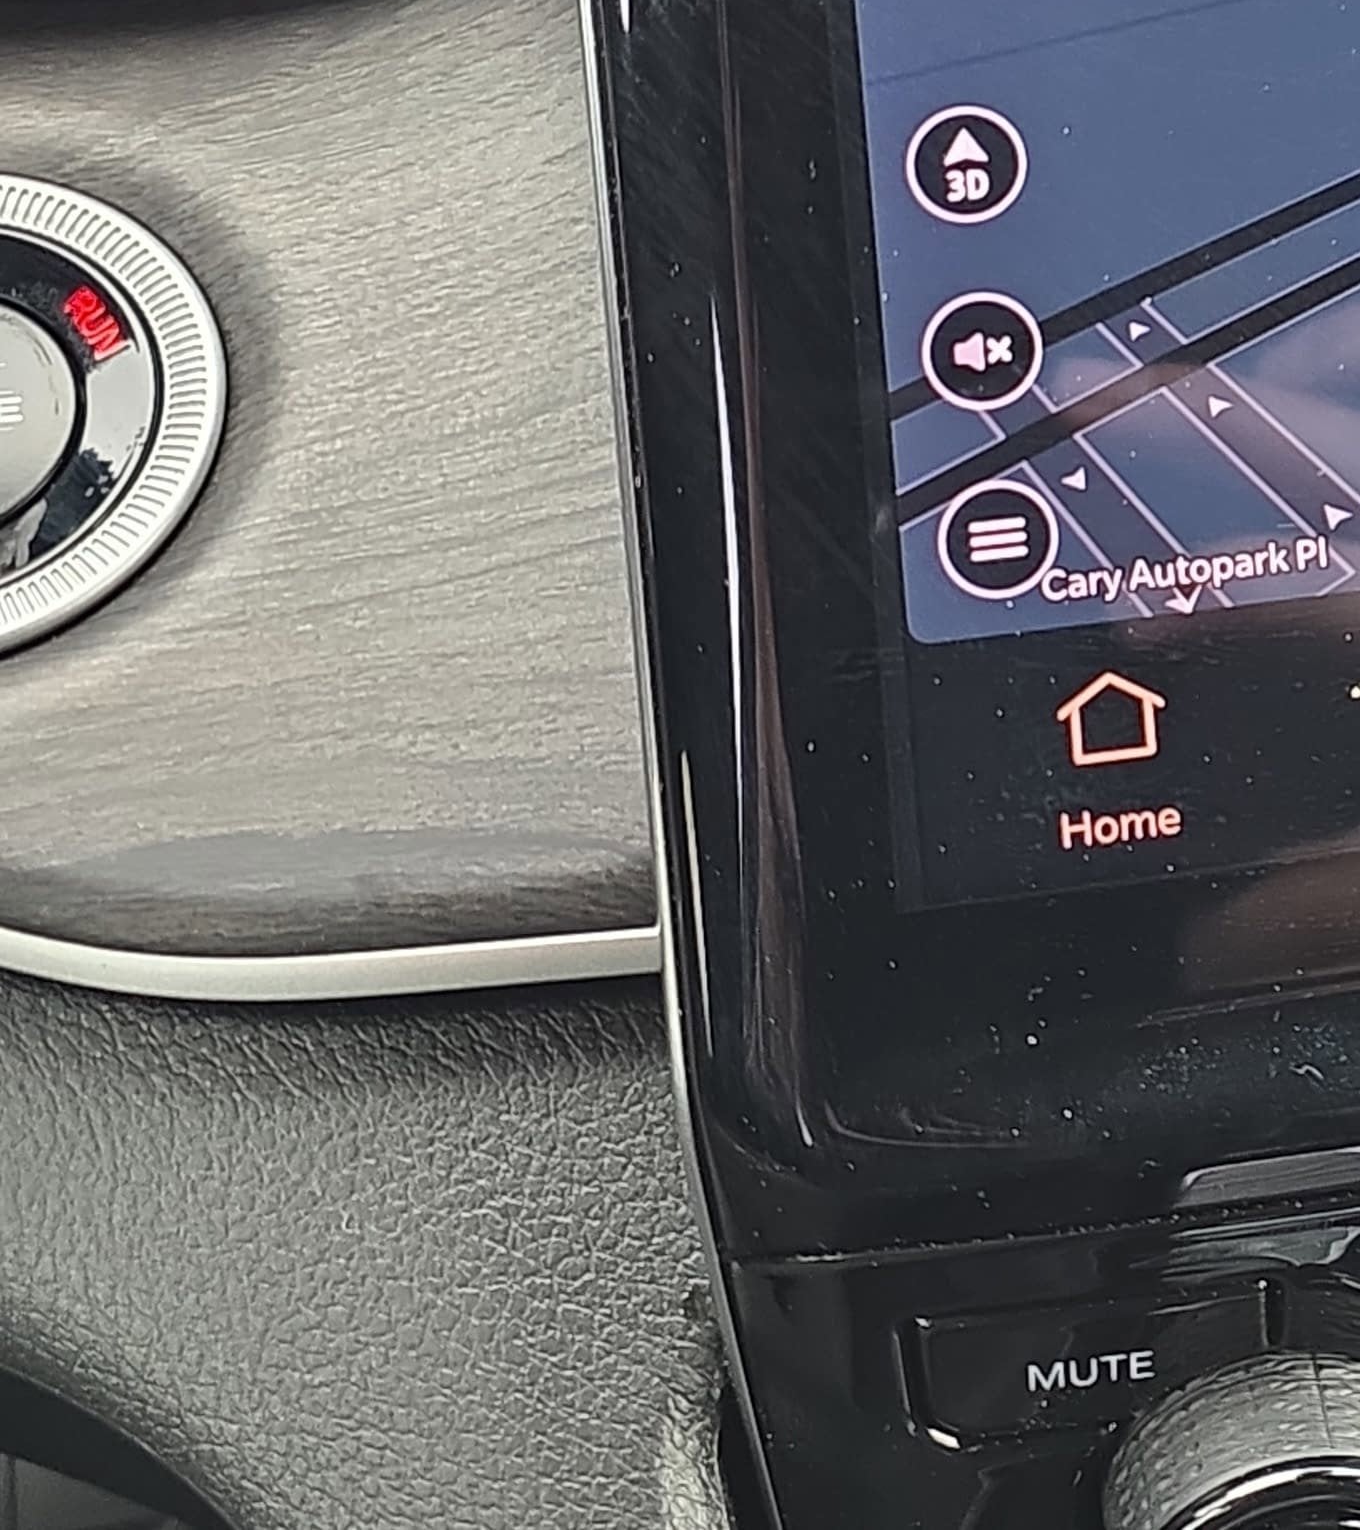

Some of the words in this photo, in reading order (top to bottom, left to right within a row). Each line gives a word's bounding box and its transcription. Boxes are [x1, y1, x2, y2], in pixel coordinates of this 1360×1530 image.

[944, 168, 990, 203] 3D
[64, 285, 136, 362] RUN
[1040, 565, 1123, 604] Cary
[1128, 546, 1290, 592] Autopark
[1293, 536, 1329, 572] Pl
[1059, 806, 1182, 851] Home
[1026, 1350, 1156, 1392] MUTE
